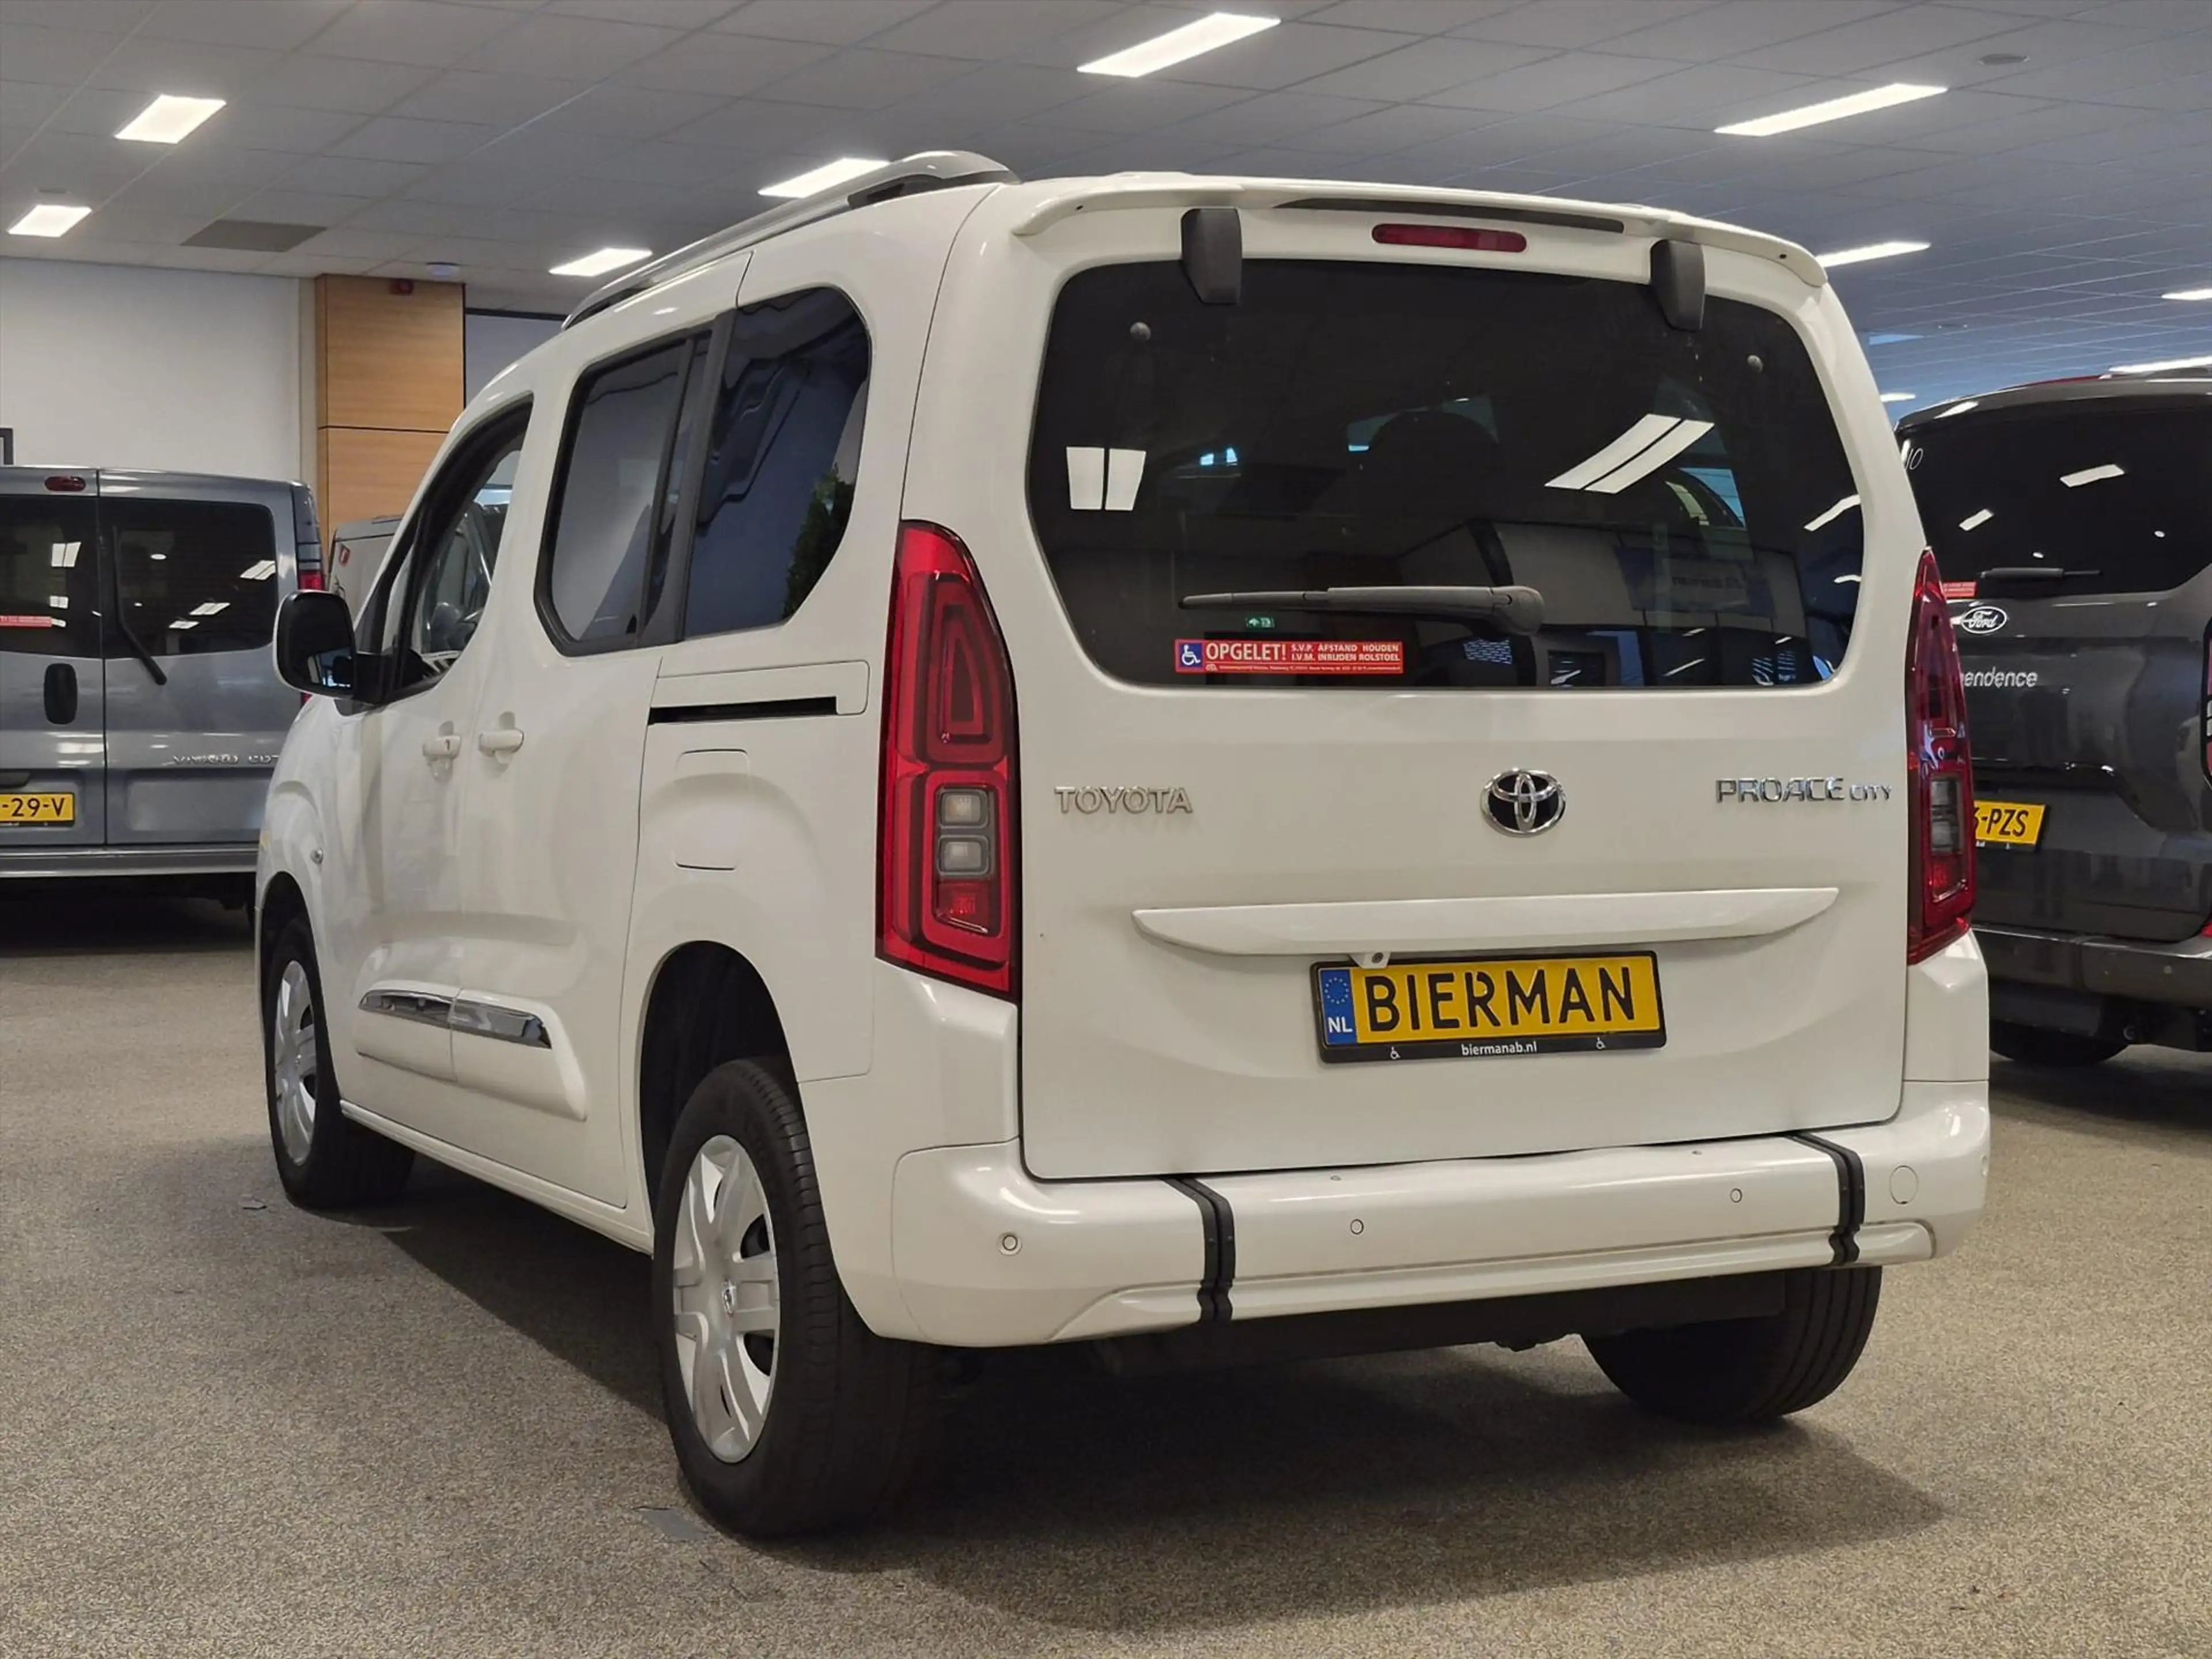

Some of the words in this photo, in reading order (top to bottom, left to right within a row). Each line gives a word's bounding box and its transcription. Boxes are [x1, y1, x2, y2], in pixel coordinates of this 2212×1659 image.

[1964, 611, 1998, 628] Ford
[1206, 642, 1286, 661] OPGELET!
[1318, 643, 1358, 652] AFSTAND
[1362, 644, 1399, 652] HOUDEN
[1715, 777, 1845, 803] PROACE
[1850, 784, 1892, 801] CITY
[1054, 786, 1193, 814] TOYOTA
[1328, 1016, 1353, 1033] NL
[1364, 967, 1635, 1032] BIERMAN
[1461, 1040, 1537, 1056] biermanab.nl
